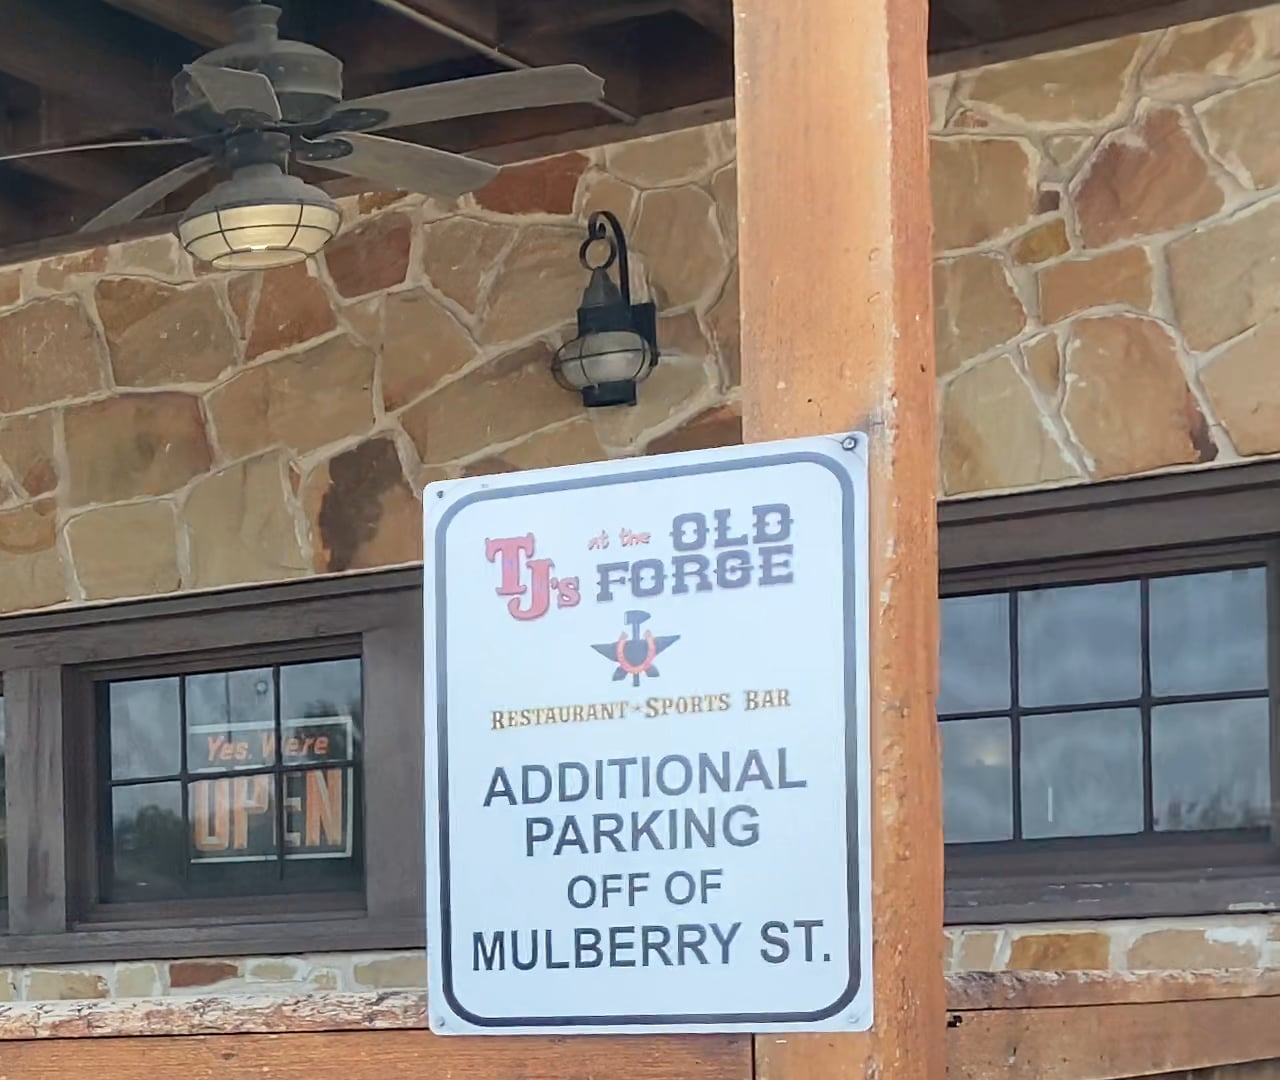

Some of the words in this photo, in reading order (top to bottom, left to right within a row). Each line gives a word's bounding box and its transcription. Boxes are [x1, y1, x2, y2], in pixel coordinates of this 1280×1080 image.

[485, 532, 581, 621] TJ's
[588, 529, 610, 550] at
[619, 527, 652, 547] the
[669, 503, 794, 552] OLD
[596, 544, 794, 602] FORGE
[744, 688, 792, 711] BAR
[483, 747, 808, 807] ADDITIONAL
[195, 766, 343, 852] OPEN
[526, 804, 761, 857] PARKING
[567, 871, 649, 909] OFF
[664, 868, 724, 906] OF
[471, 921, 740, 972] MULBERRY
[759, 918, 831, 965] ST.
